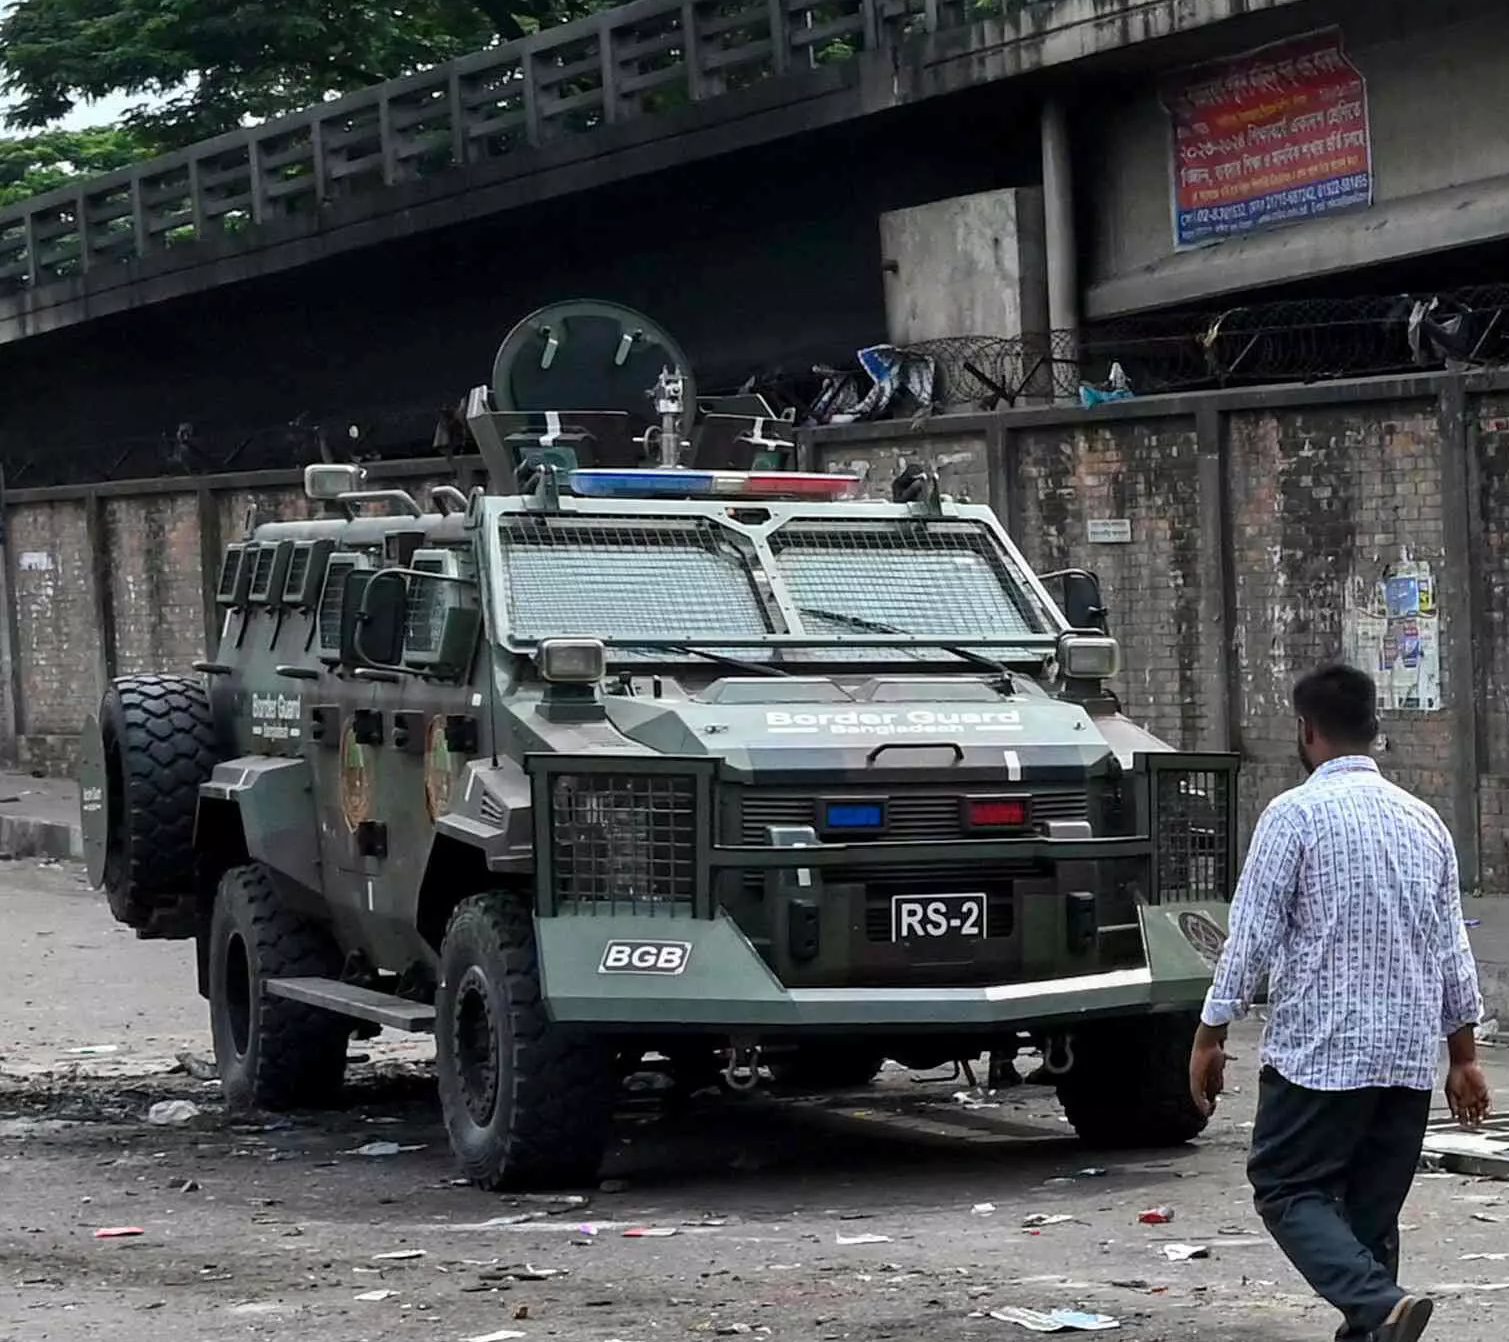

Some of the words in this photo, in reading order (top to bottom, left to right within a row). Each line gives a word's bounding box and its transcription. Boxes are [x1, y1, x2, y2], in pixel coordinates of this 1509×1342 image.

[765, 711, 897, 726] Border
[905, 710, 1021, 725] Guard
[830, 724, 965, 736] Bangladesh
[900, 901, 981, 937] RS-2
[605, 945, 685, 969] BGB
